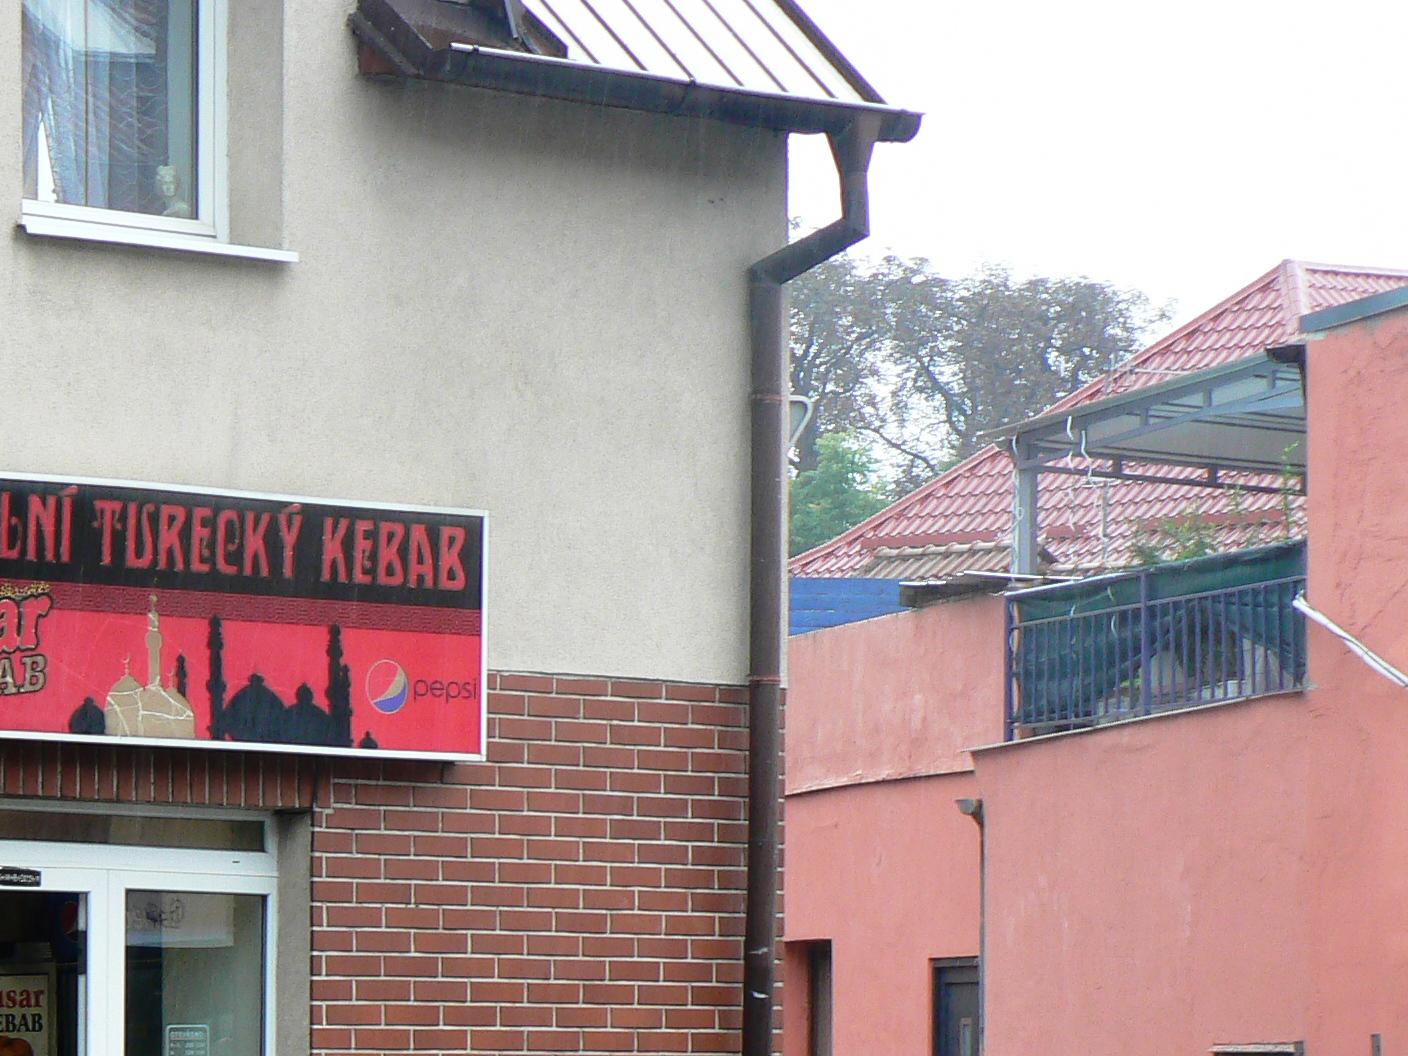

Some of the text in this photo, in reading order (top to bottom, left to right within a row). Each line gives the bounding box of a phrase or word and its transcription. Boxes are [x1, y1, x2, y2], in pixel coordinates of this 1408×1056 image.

[93, 499, 302, 580] TURECKÝ
[321, 515, 468, 592] KEBAB
[413, 676, 478, 702] pepsi
